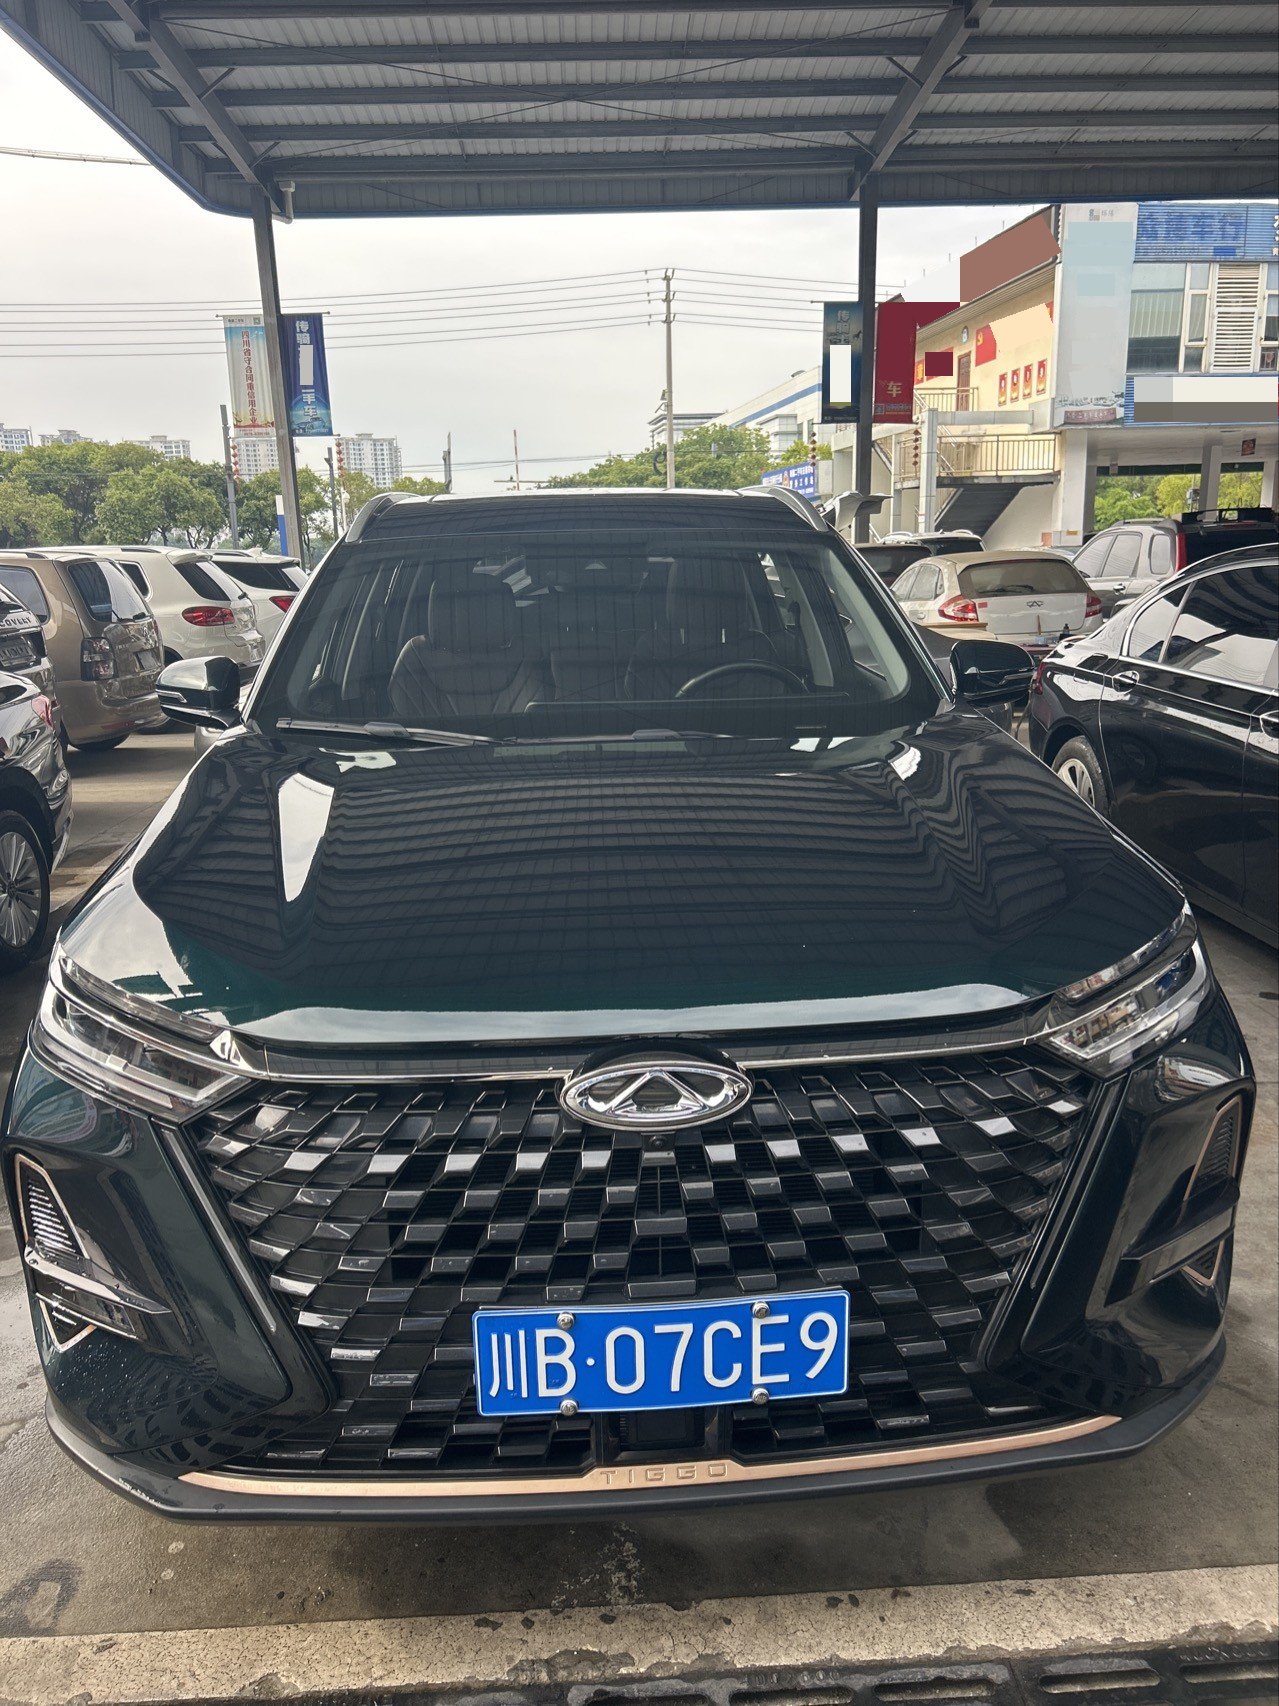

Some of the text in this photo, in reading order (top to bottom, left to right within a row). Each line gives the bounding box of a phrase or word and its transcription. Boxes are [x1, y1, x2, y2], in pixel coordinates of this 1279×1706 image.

[241, 330, 257, 424] 四川省守合同重信用企业
[886, 381, 903, 398] 车
[600, 1463, 728, 1485] TIGGO
